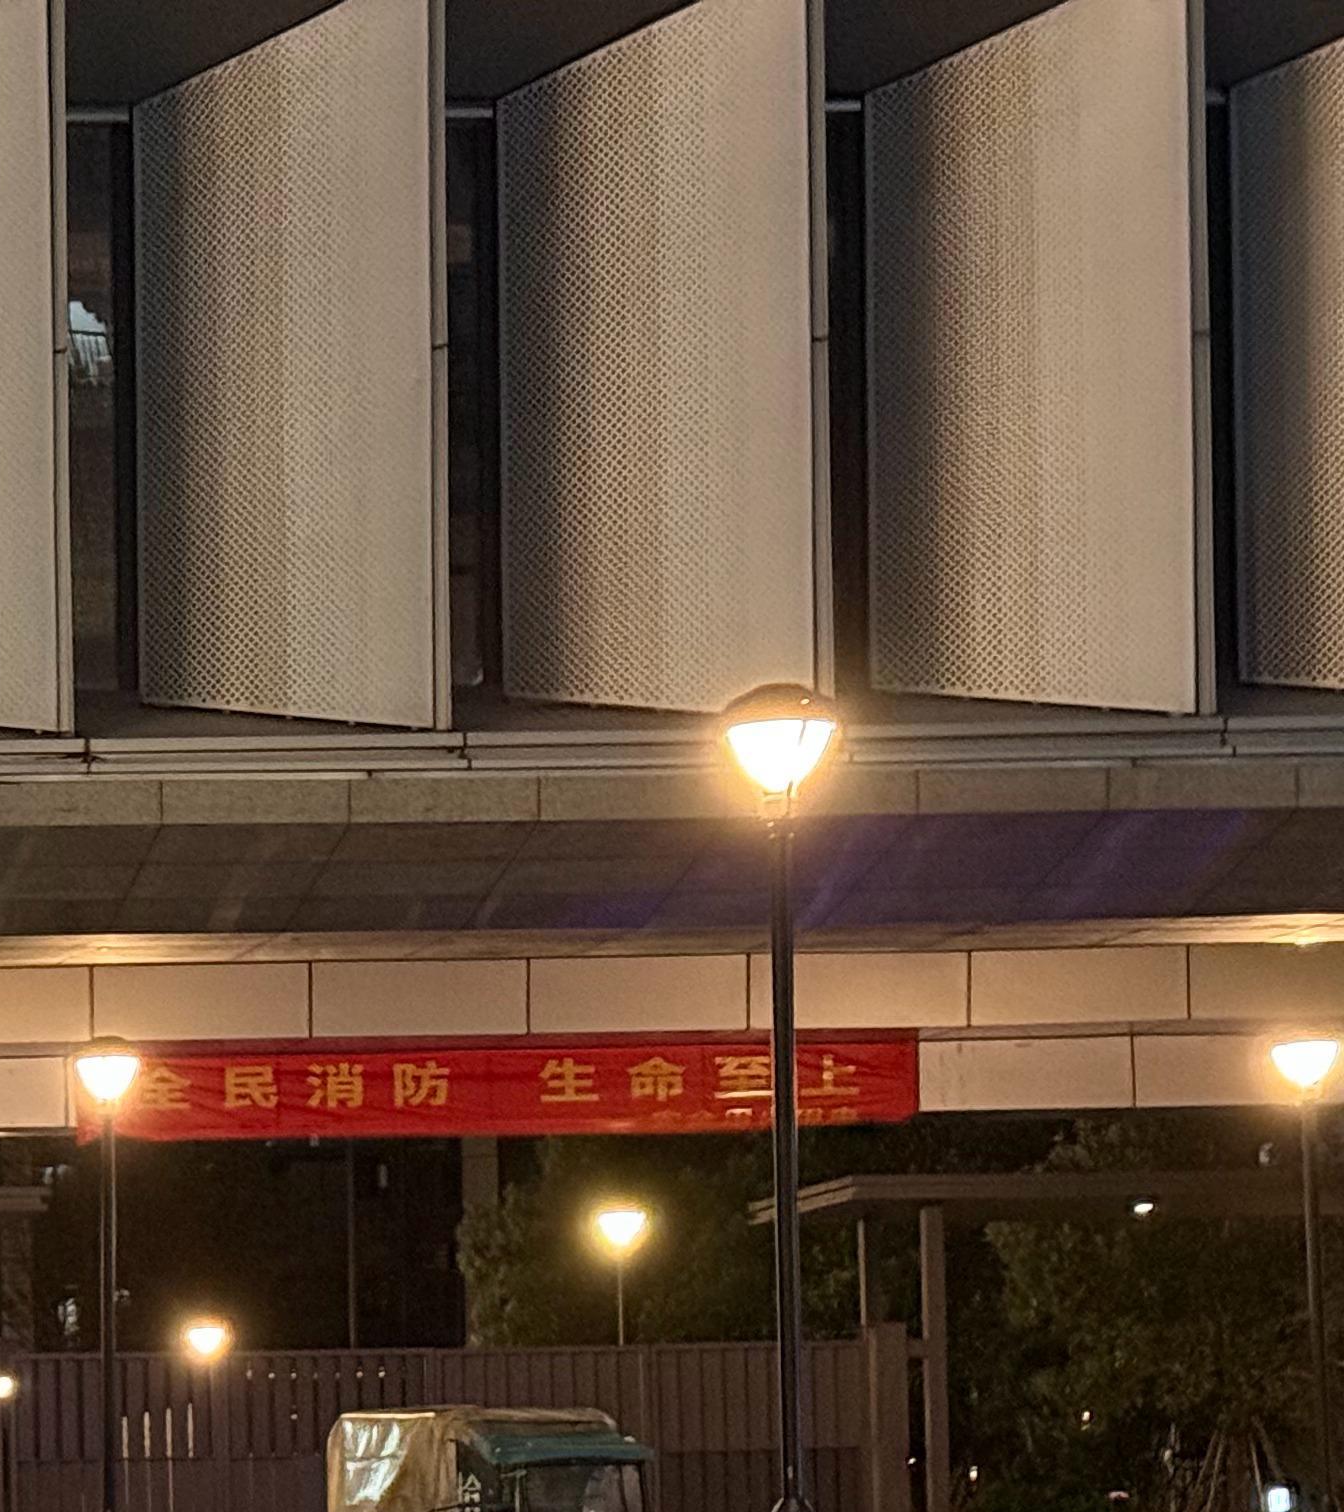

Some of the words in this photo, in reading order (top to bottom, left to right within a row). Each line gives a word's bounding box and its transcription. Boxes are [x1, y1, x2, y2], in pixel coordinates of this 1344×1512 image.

[141, 1060, 450, 1110] 全民消防
[539, 1054, 860, 1103] 生命至上
